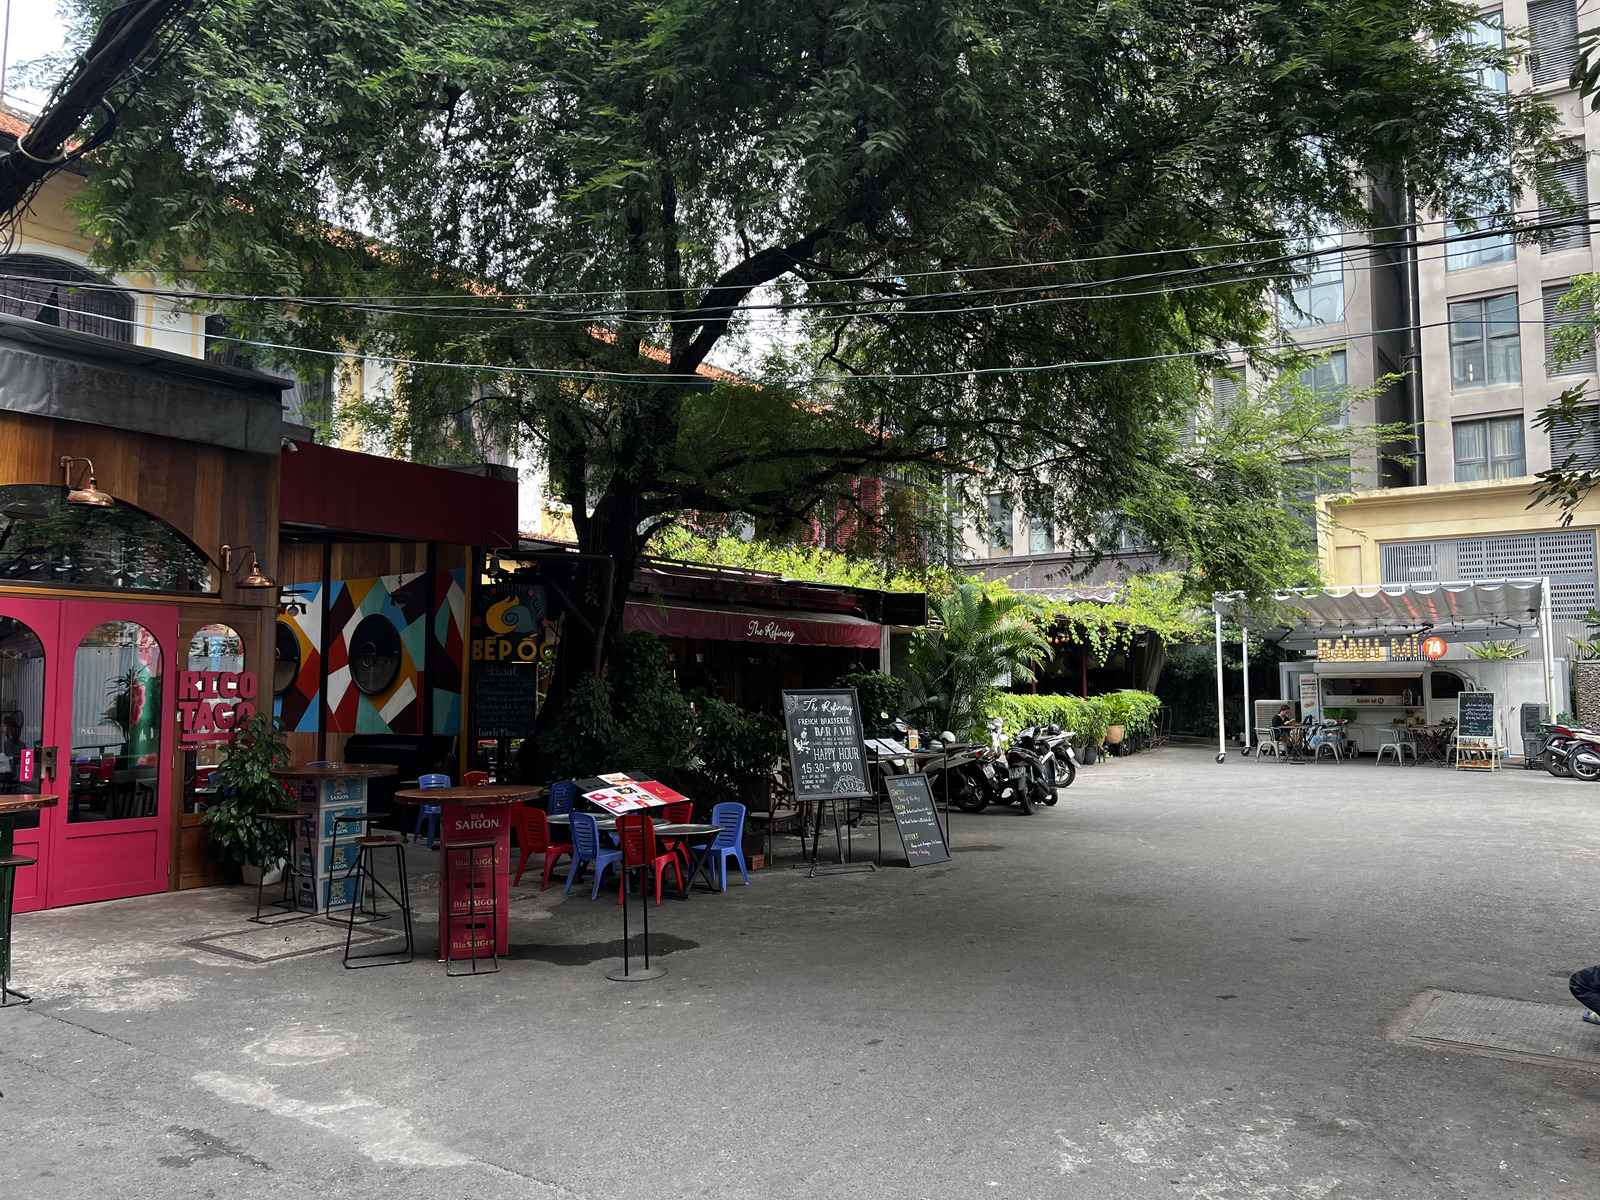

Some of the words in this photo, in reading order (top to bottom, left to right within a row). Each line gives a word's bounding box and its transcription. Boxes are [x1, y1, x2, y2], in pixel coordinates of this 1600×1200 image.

[497, 583, 527, 594] DRINK
[747, 620, 764, 637] The
[764, 621, 795, 643] Refinery
[472, 634, 513, 660] BẾP
[1317, 635, 1380, 659] BÁNH
[1427, 640, 1442, 656] 74
[178, 671, 257, 699] RICO
[803, 698, 818, 711] The
[821, 700, 853, 716] Refinery
[178, 702, 255, 731] TACO
[798, 718, 819, 726] FRENCH
[820, 717, 850, 725] BRASSERIE
[814, 726, 832, 736] BAR
[840, 726, 856, 735] VIN
[813, 748, 836, 760] HAPPY
[838, 747, 860, 760] HOUR
[802, 763, 825, 774] 15:30
[832, 761, 853, 772] 18:00
[455, 819, 500, 830] SAIGON
